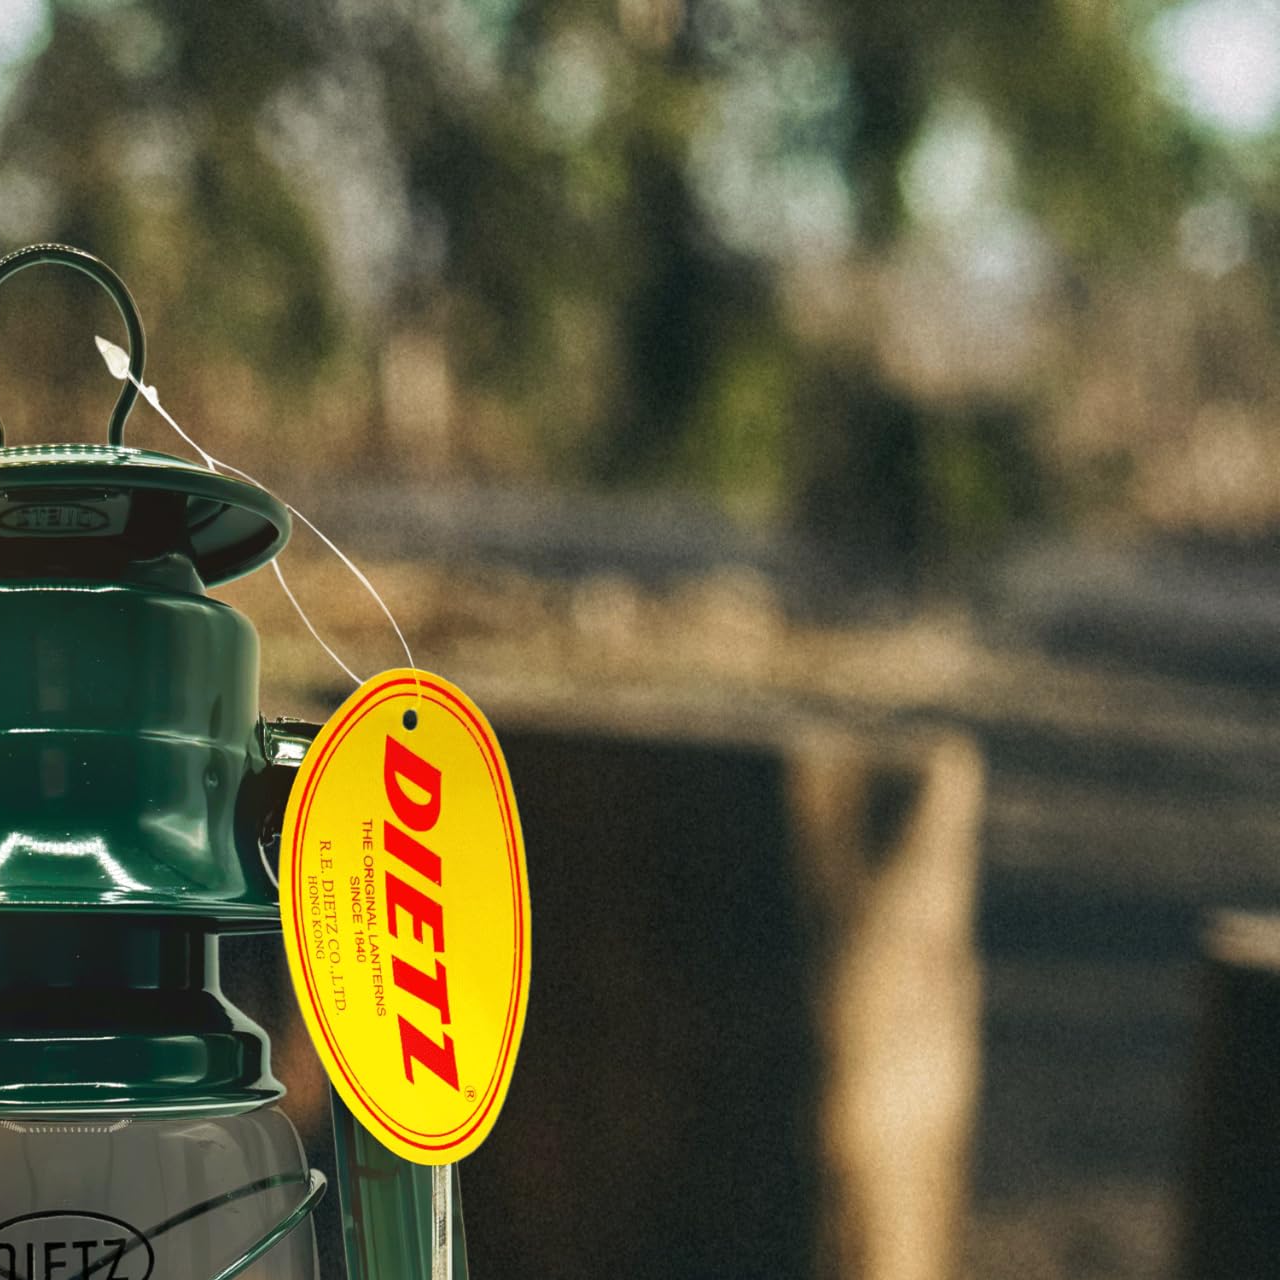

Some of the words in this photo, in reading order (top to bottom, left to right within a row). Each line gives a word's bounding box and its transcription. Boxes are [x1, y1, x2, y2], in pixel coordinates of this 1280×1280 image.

[319, 840, 333, 874] R.E.
[361, 818, 374, 851] THE
[307, 875, 322, 917] HONG
[322, 879, 339, 935] DIETZ
[349, 875, 364, 924] SINCE
[363, 854, 378, 931] ORIGINAL
[383, 734, 461, 1093] DIETZ
[312, 919, 326, 960] KONG
[354, 929, 367, 963] 1840
[368, 934, 387, 1017] LANTERNS
